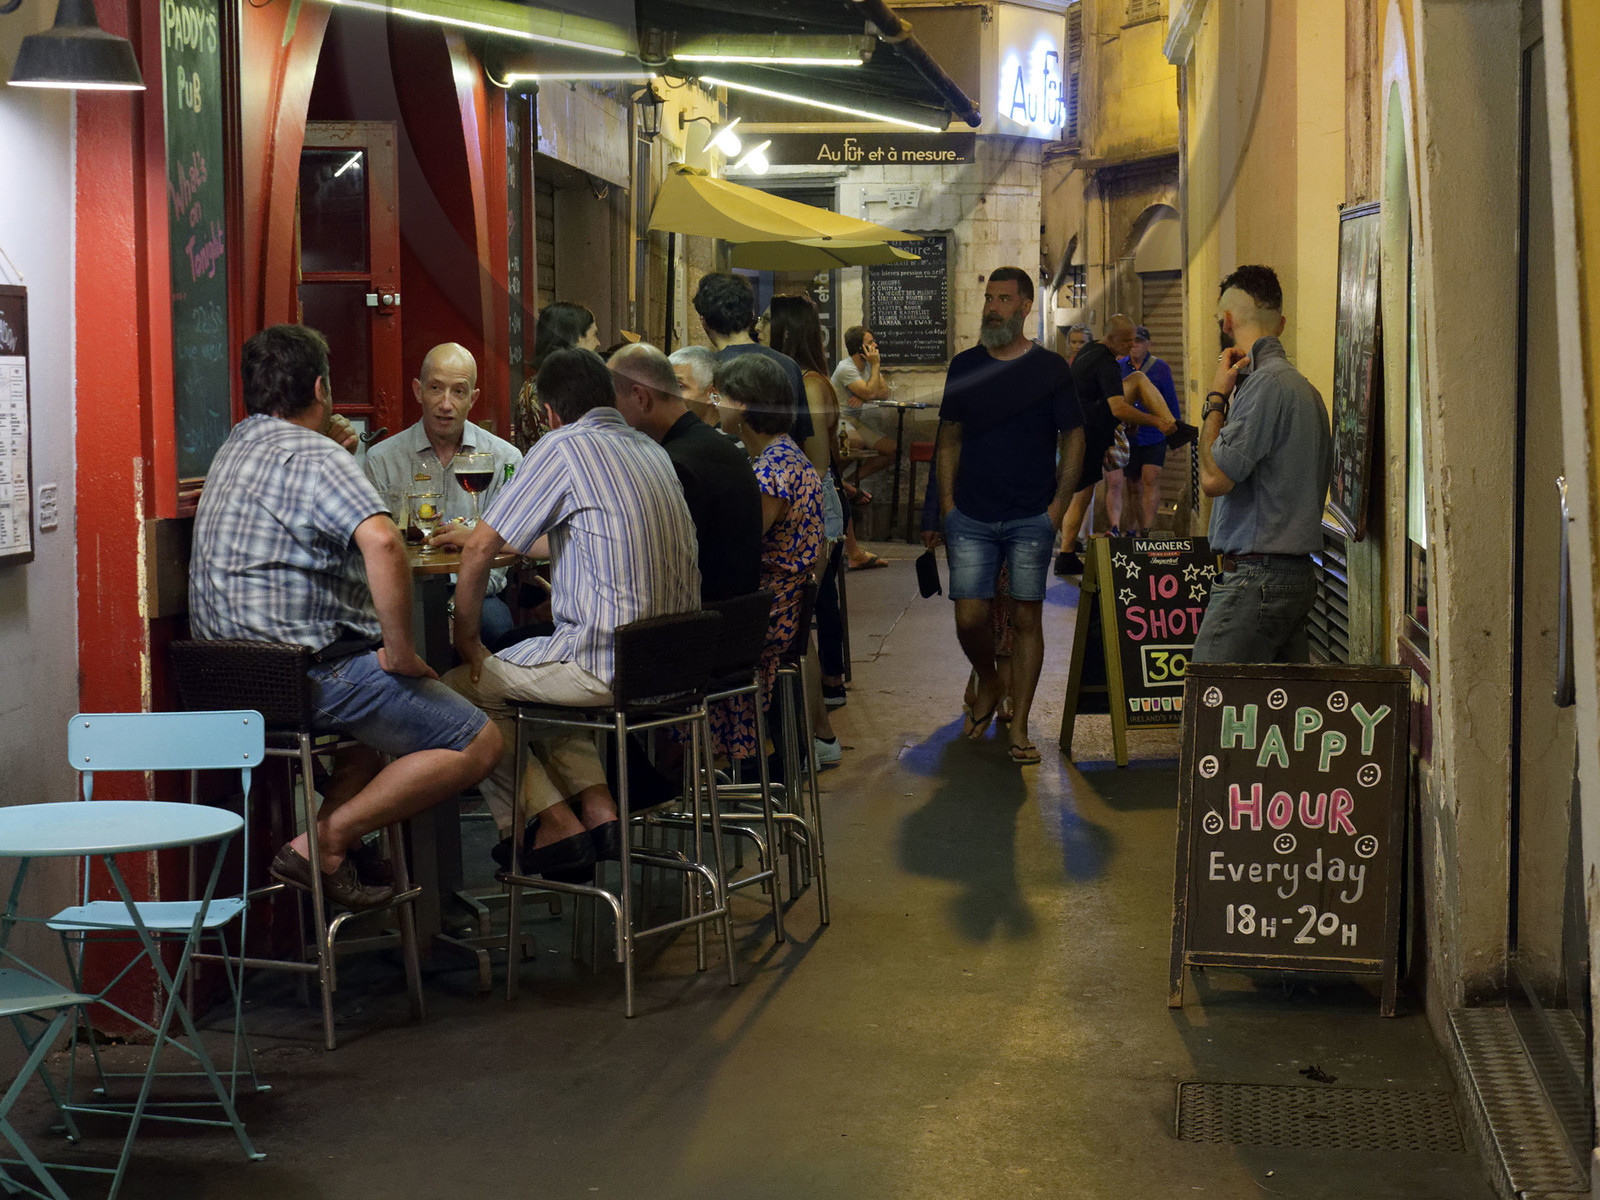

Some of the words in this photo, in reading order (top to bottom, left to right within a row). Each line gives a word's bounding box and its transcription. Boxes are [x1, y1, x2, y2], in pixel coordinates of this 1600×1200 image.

[1010, 65, 1037, 123] Au
[817, 144, 841, 161] Au
[868, 147, 885, 161] et
[887, 147, 897, 161] à
[902, 150, 965, 161] mesure...
[1135, 541, 1191, 551] MAGNERS
[1149, 574, 1178, 600] 10
[1126, 606, 1208, 641] SHOT
[1130, 713, 1167, 723] IRELAND'S
[1220, 702, 1391, 773] HAPPY
[1228, 783, 1357, 836] HOUR
[1209, 848, 1366, 903] Everyday
